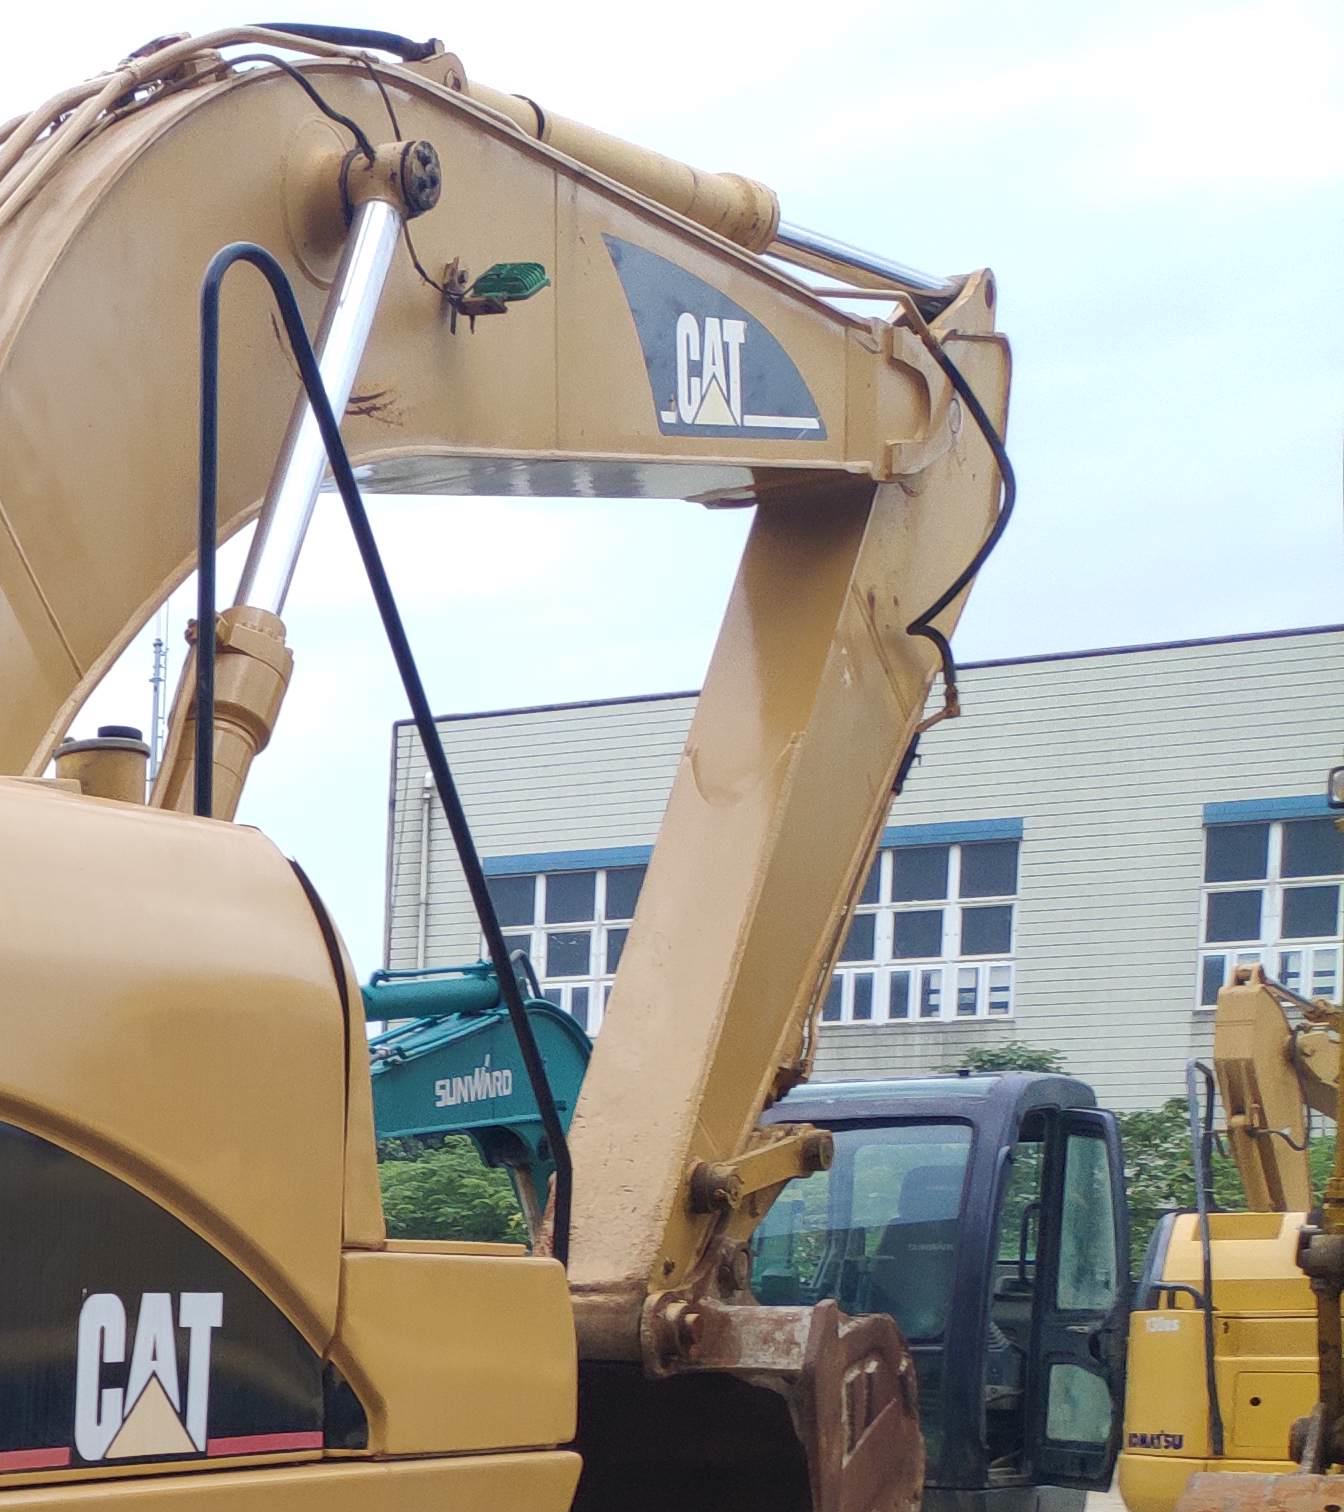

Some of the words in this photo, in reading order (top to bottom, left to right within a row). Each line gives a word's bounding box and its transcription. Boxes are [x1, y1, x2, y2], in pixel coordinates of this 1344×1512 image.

[676, 312, 747, 427] CAT
[434, 1054, 513, 1107] SUNWARD
[74, 1292, 224, 1461] CAT
